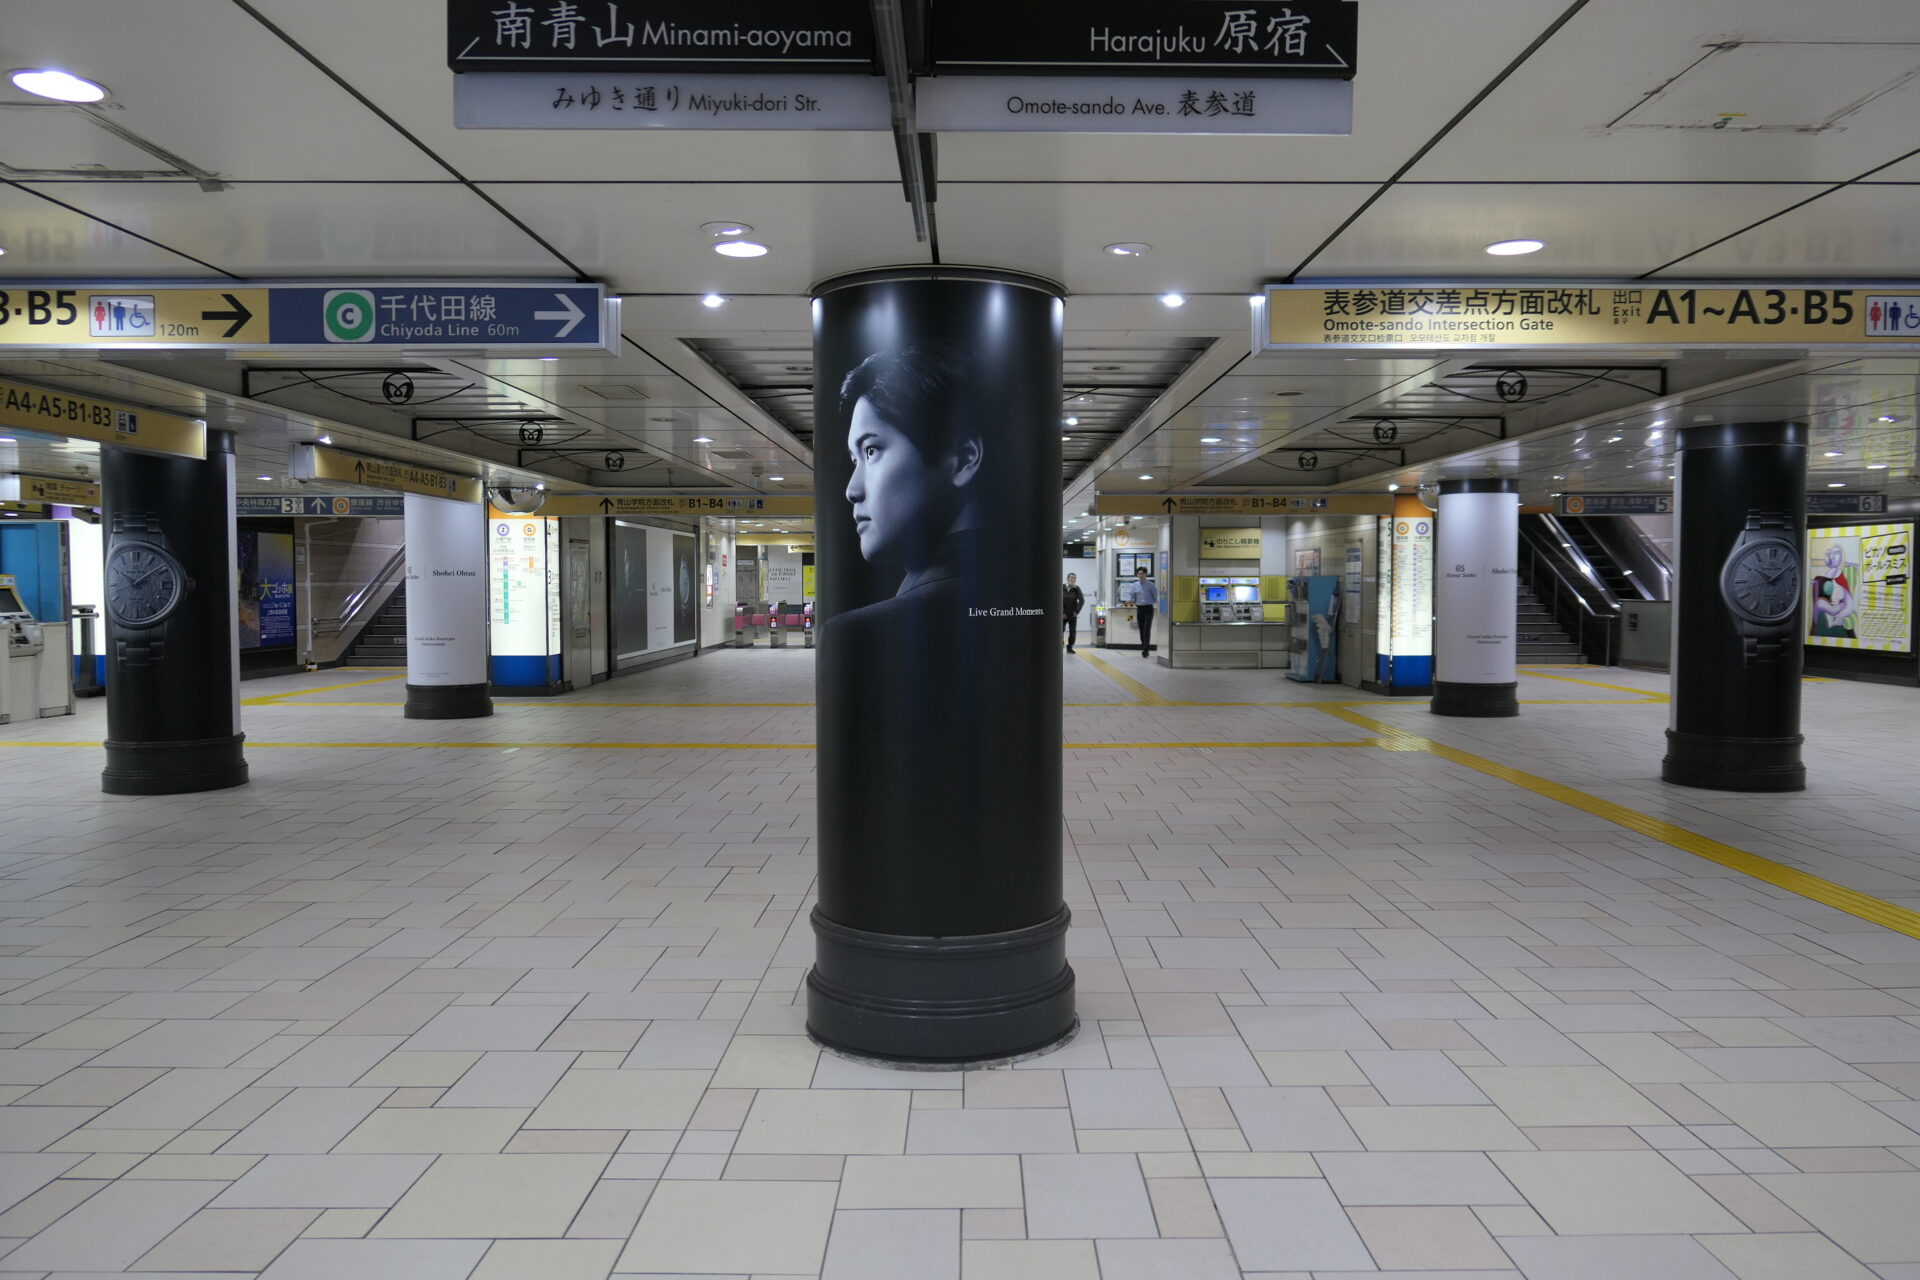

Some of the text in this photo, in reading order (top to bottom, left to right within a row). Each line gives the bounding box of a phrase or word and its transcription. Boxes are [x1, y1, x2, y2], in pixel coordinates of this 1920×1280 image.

[490, 1, 852, 53] 南青山 Minami-aoyama
[1090, 8, 1312, 59] Harajuku 原宿
[552, 86, 822, 115] みゆき通り Miyuki-dori Str.
[1006, 90, 1257, 118] Omote-sando Ave. 表参道
[1323, 289, 1600, 316] 表参道交差点方面改札
[1613, 289, 1642, 304] 出口
[380, 294, 497, 322] 千代田線
[1613, 306, 1642, 317] Exit
[343, 307, 356, 325] C
[160, 323, 200, 337] 120m
[381, 323, 520, 338] Chiyoda Line 60m
[1323, 318, 1554, 331] Omote-sando Intersection Gate
[284, 499, 294, 513] 3
[1658, 497, 1669, 512] 5
[1862, 496, 1872, 511] 6
[432, 569, 455, 577] Shohei
[968, 607, 1045, 617] Live Grand Moments.
